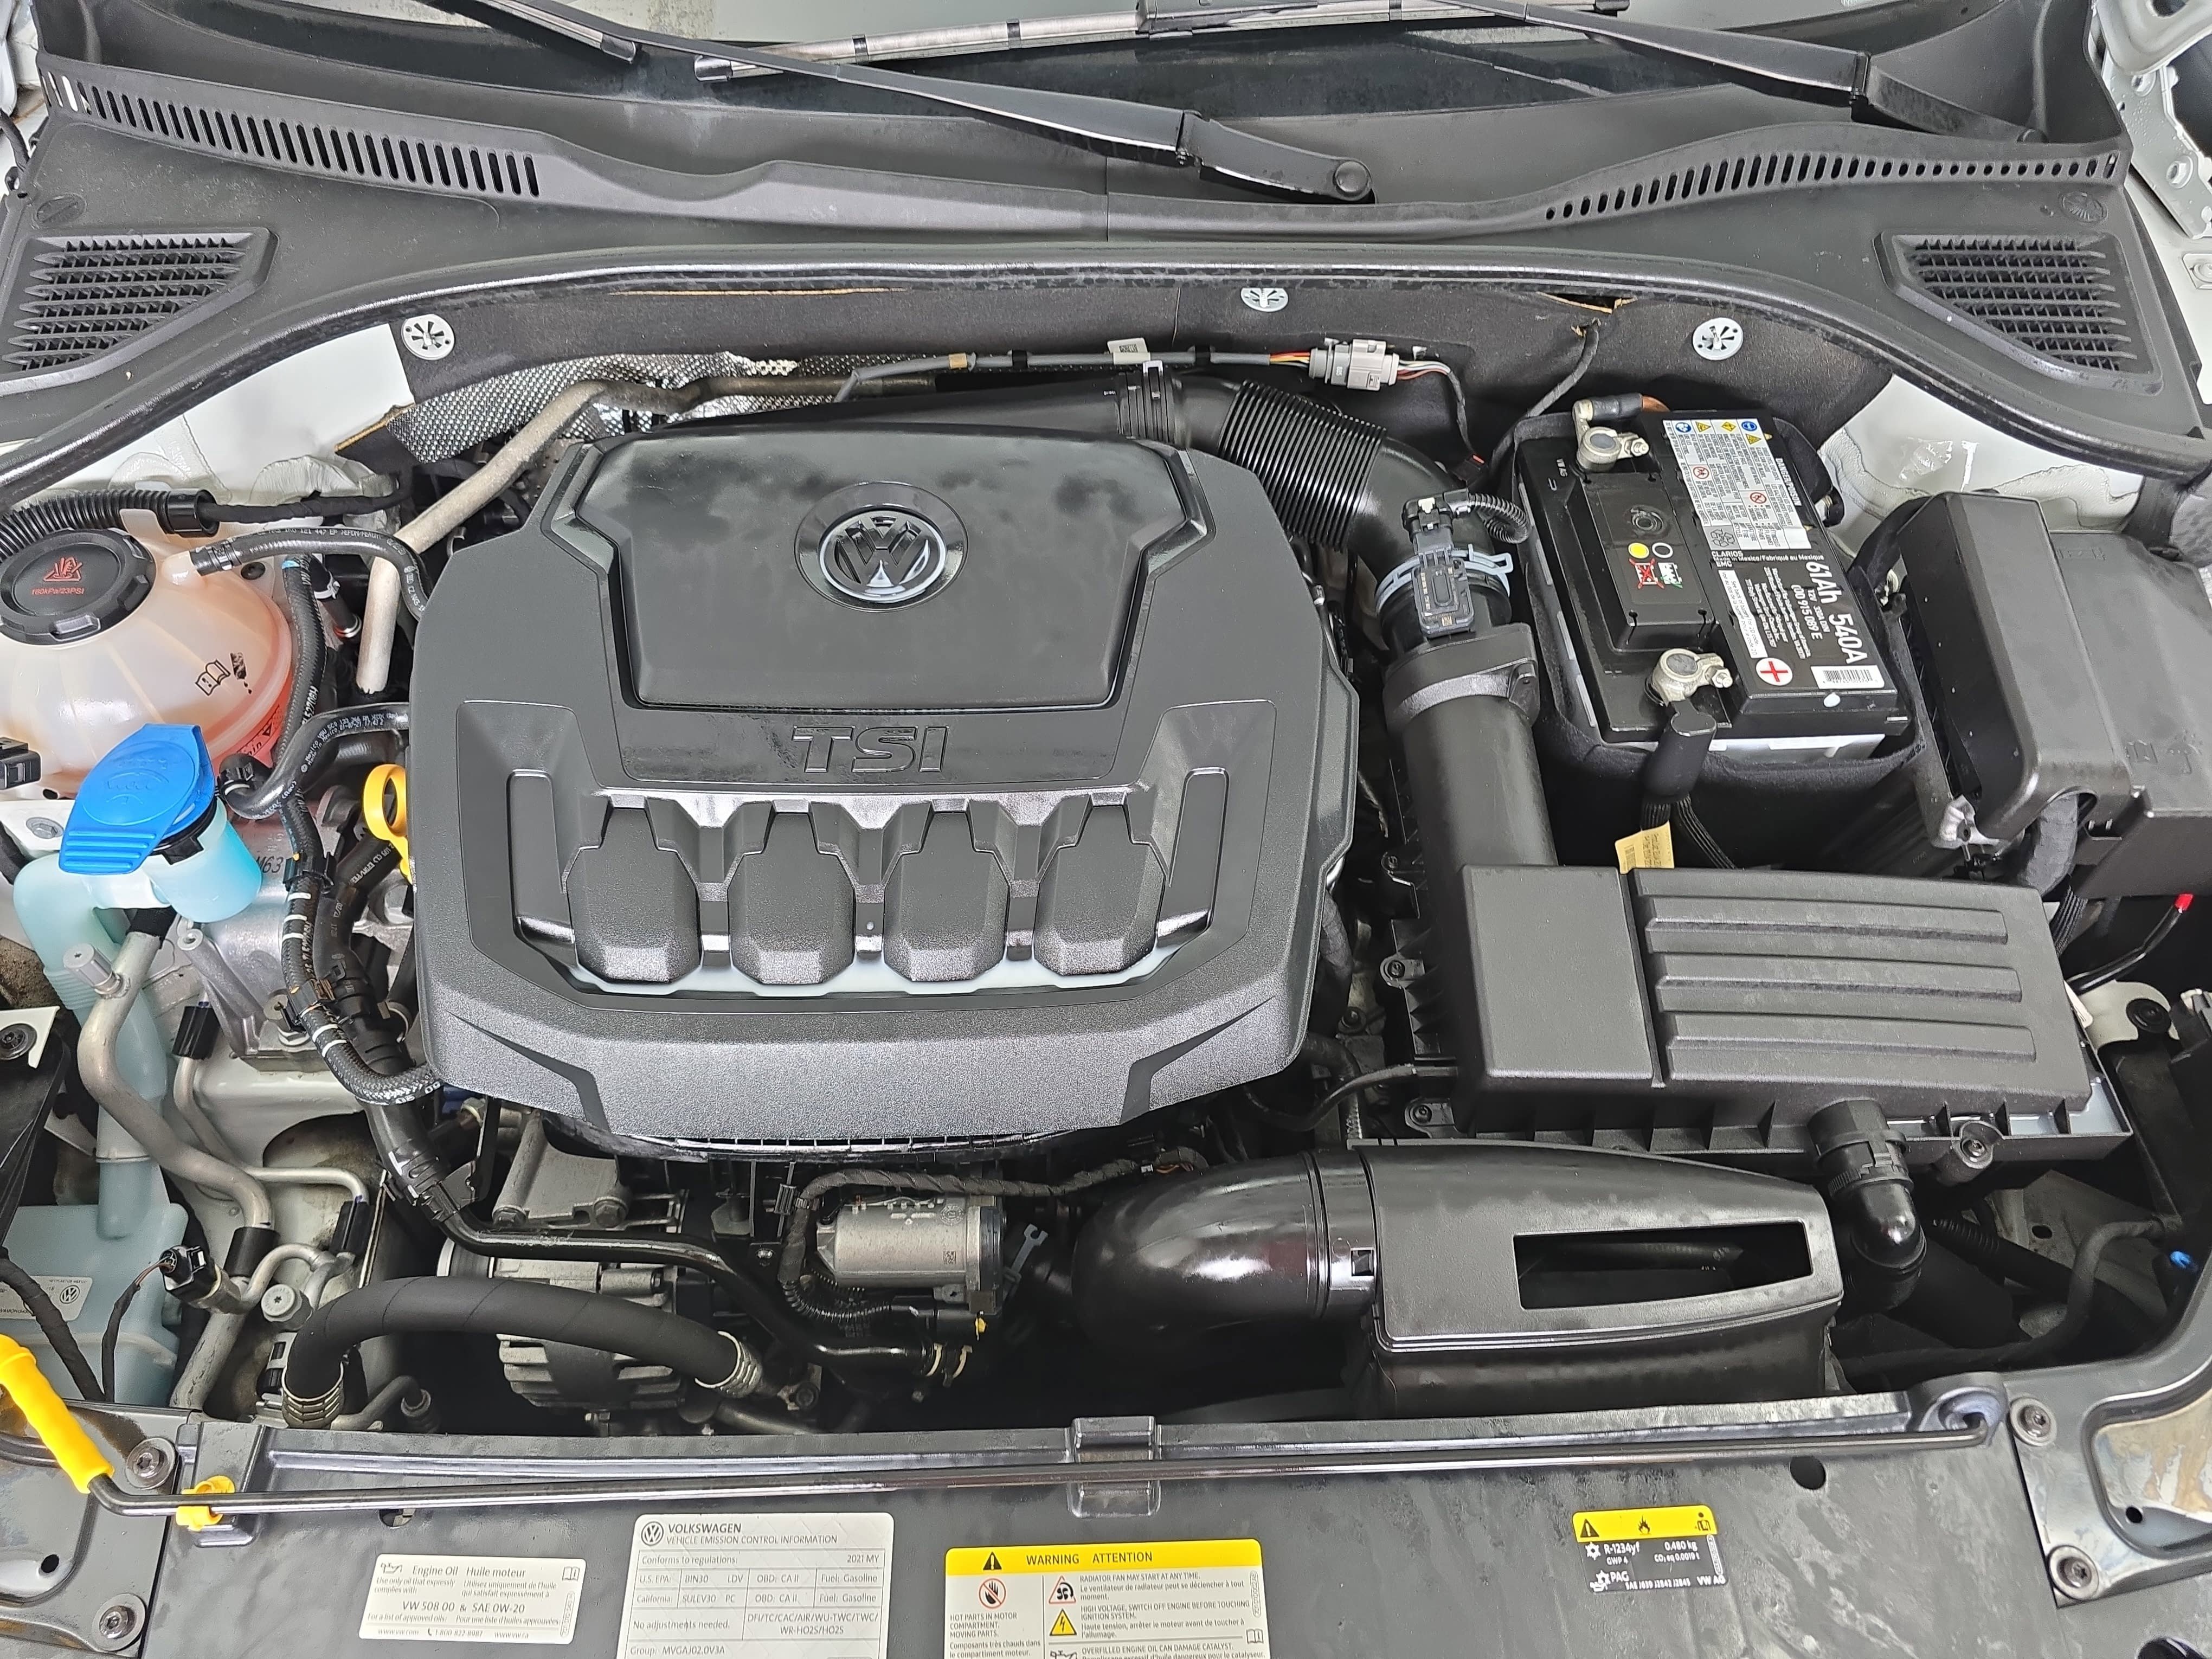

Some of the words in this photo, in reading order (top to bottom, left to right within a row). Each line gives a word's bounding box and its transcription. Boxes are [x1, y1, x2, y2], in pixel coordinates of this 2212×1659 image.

[1774, 458, 1802, 506] DANGER/POISON
[1798, 600, 1812, 615] 915
[1806, 561, 1842, 604] 61Ah
[1828, 614, 1868, 664] 540A
[1808, 589, 1817, 602] 12V
[1814, 606, 1824, 620] 330A
[1819, 621, 1830, 632] DIN
[1804, 616, 1819, 631] 089
[792, 725, 949, 773] TSI
[668, 1523, 741, 1533] VOLKSWAGEN
[666, 1536, 698, 1545] VEHICLE
[700, 1535, 739, 1544] EMISSION
[741, 1535, 779, 1544] CONTROL
[781, 1535, 837, 1544] INFORMATION
[1604, 1541, 1639, 1555] R-1234yf
[1664, 1541, 1686, 1551] 0.480
[1687, 1540, 1697, 1551] kg
[642, 1555, 679, 1564] Conforms
[681, 1556, 690, 1564] to
[691, 1555, 737, 1566] regulations:
[847, 1554, 864, 1562] 2021
[866, 1554, 879, 1562] MY
[1026, 1554, 1079, 1565] WARNING
[1092, 1552, 1153, 1563] ATTENTION
[1606, 1557, 1622, 1565] GWP
[411, 1565, 443, 1577] Engine
[445, 1566, 459, 1576] Oil
[465, 1566, 491, 1577] Huile
[491, 1567, 526, 1578] moteur
[654, 1576, 671, 1584] EPA:
[727, 1575, 743, 1583] LDV
[821, 1574, 839, 1583] Fuel:
[843, 1574, 877, 1583] Gasoline
[1610, 1571, 1629, 1582] PAG
[1697, 1577, 1712, 1585] VW
[388, 1578, 403, 1586] only
[425, 1579, 455, 1587] expressly
[487, 1580, 528, 1590] uniquement
[1165, 1583, 1179, 1591] peut
[1189, 1580, 1223, 1589] déclencher
[636, 1594, 673, 1603] California:
[682, 1594, 716, 1603] SULEV30
[725, 1594, 735, 1603] PC
[755, 1594, 775, 1603] OBD:
[779, 1594, 791, 1603] CA
[819, 1593, 838, 1603] Fuel:
[842, 1593, 876, 1602] Gasoline
[401, 1601, 420, 1610] VW
[421, 1602, 440, 1611] 508
[441, 1602, 455, 1611] 00
[471, 1603, 491, 1612] SAE
[492, 1603, 525, 1613] 0W-20
[1098, 1604, 1127, 1613] VOLTAGE,
[1192, 1601, 1216, 1609] BEFORE
[950, 1613, 963, 1622] HOT
[965, 1612, 984, 1621] PARTS
[633, 1621, 645, 1629] No
[646, 1621, 696, 1631] adjustments
[697, 1620, 730, 1630] needed.
[950, 1622, 999, 1630] COMPARTMENT.
[1102, 1622, 1128, 1631] tension,
[1129, 1621, 1151, 1629] arrêter
[1214, 1618, 1238, 1626] toucher
[950, 1630, 975, 1638] MOVING
[978, 1630, 998, 1638] PARTS.
[1081, 1630, 1116, 1638] l'allumage.
[629, 1646, 657, 1657] Group:
[661, 1645, 725, 1655] MVGAJ02.0V3A
[950, 1641, 988, 1651] Composants
[1082, 1646, 1120, 1654] OVERFILLED
[1202, 1642, 1233, 1650] CATALYST.
[957, 1650, 1002, 1659] compartiment
